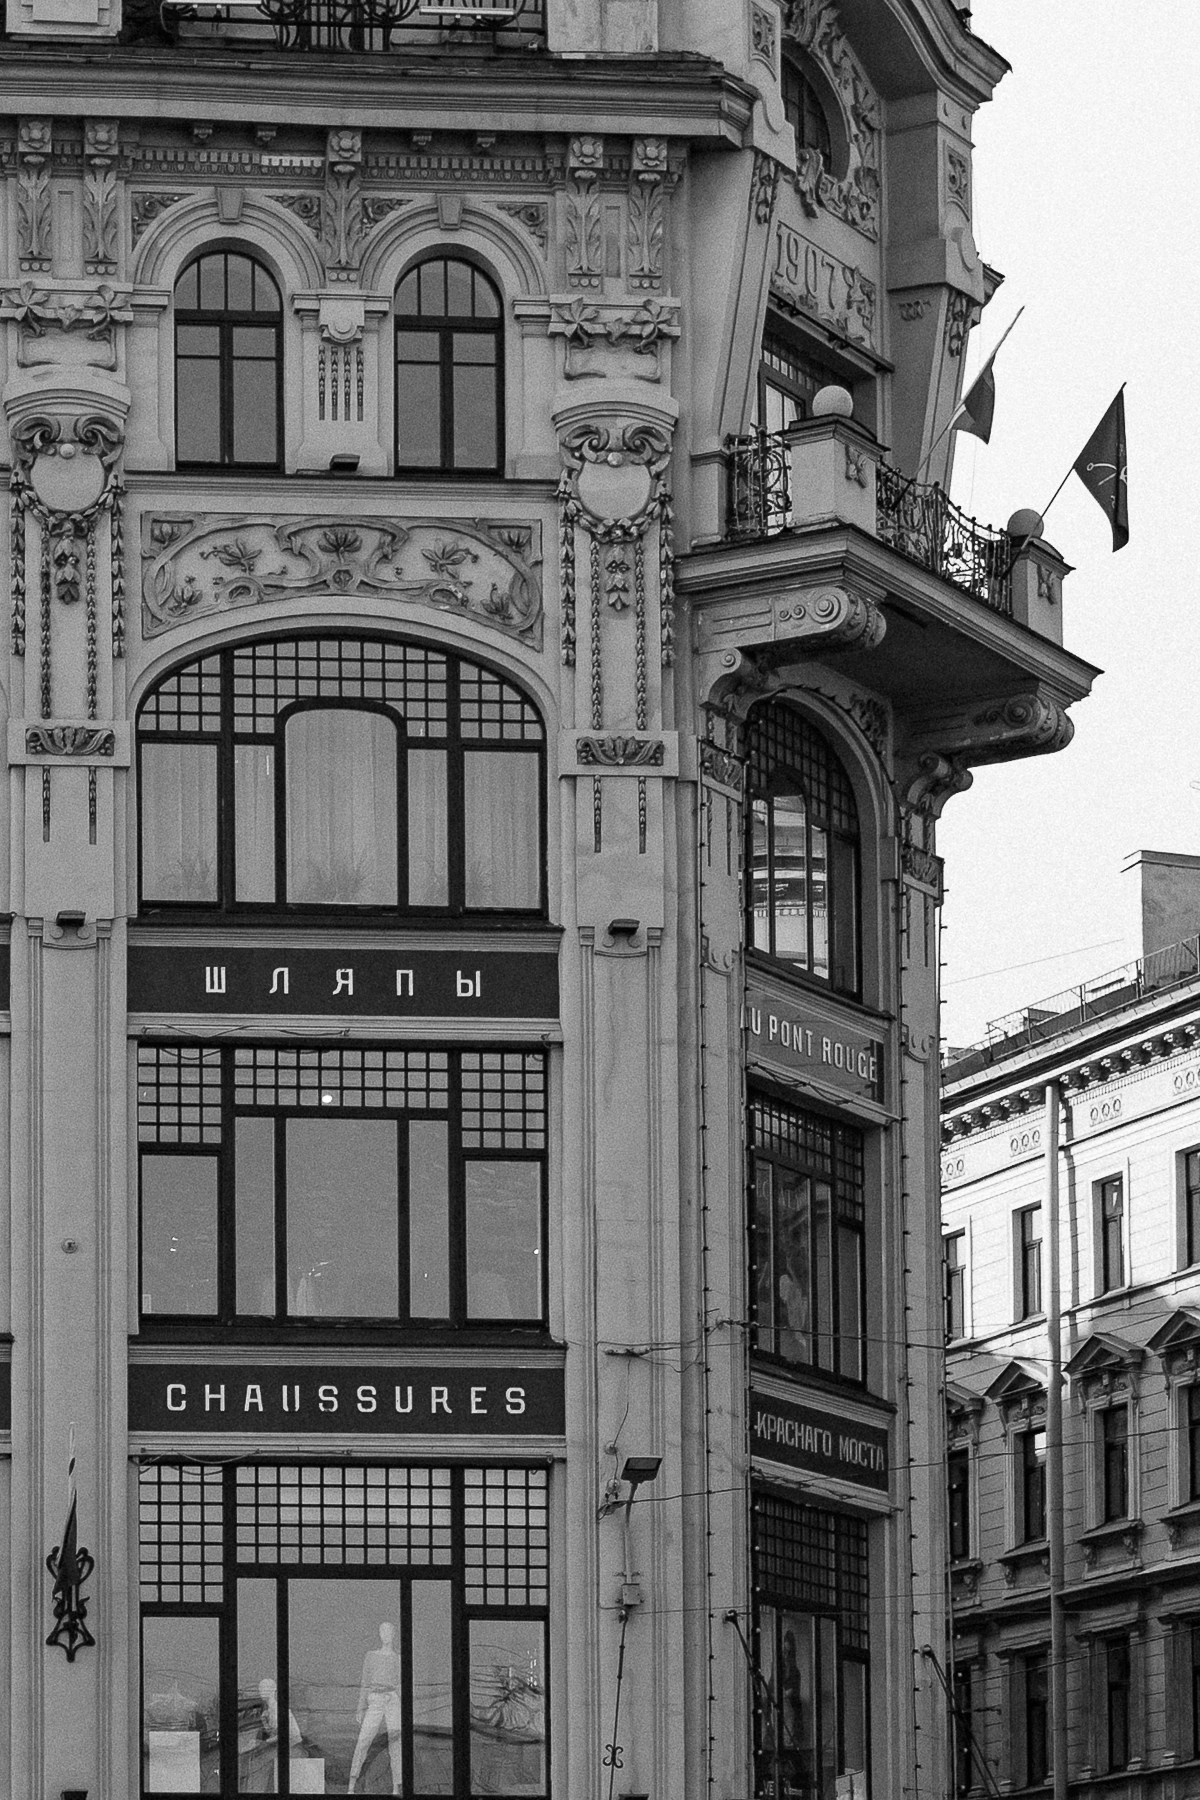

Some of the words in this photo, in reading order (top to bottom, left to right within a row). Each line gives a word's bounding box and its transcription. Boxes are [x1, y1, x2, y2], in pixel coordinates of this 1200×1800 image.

[774, 223, 836, 310] 1907
[205, 966, 481, 998] ШЛЯПЫ
[769, 1015, 813, 1057] PONT
[822, 1036, 878, 1083] ROUGE
[166, 1383, 526, 1415] CHAUSSURES
[757, 1411, 832, 1457] КРАСНАГО
[839, 1434, 885, 1471] МОСТА
